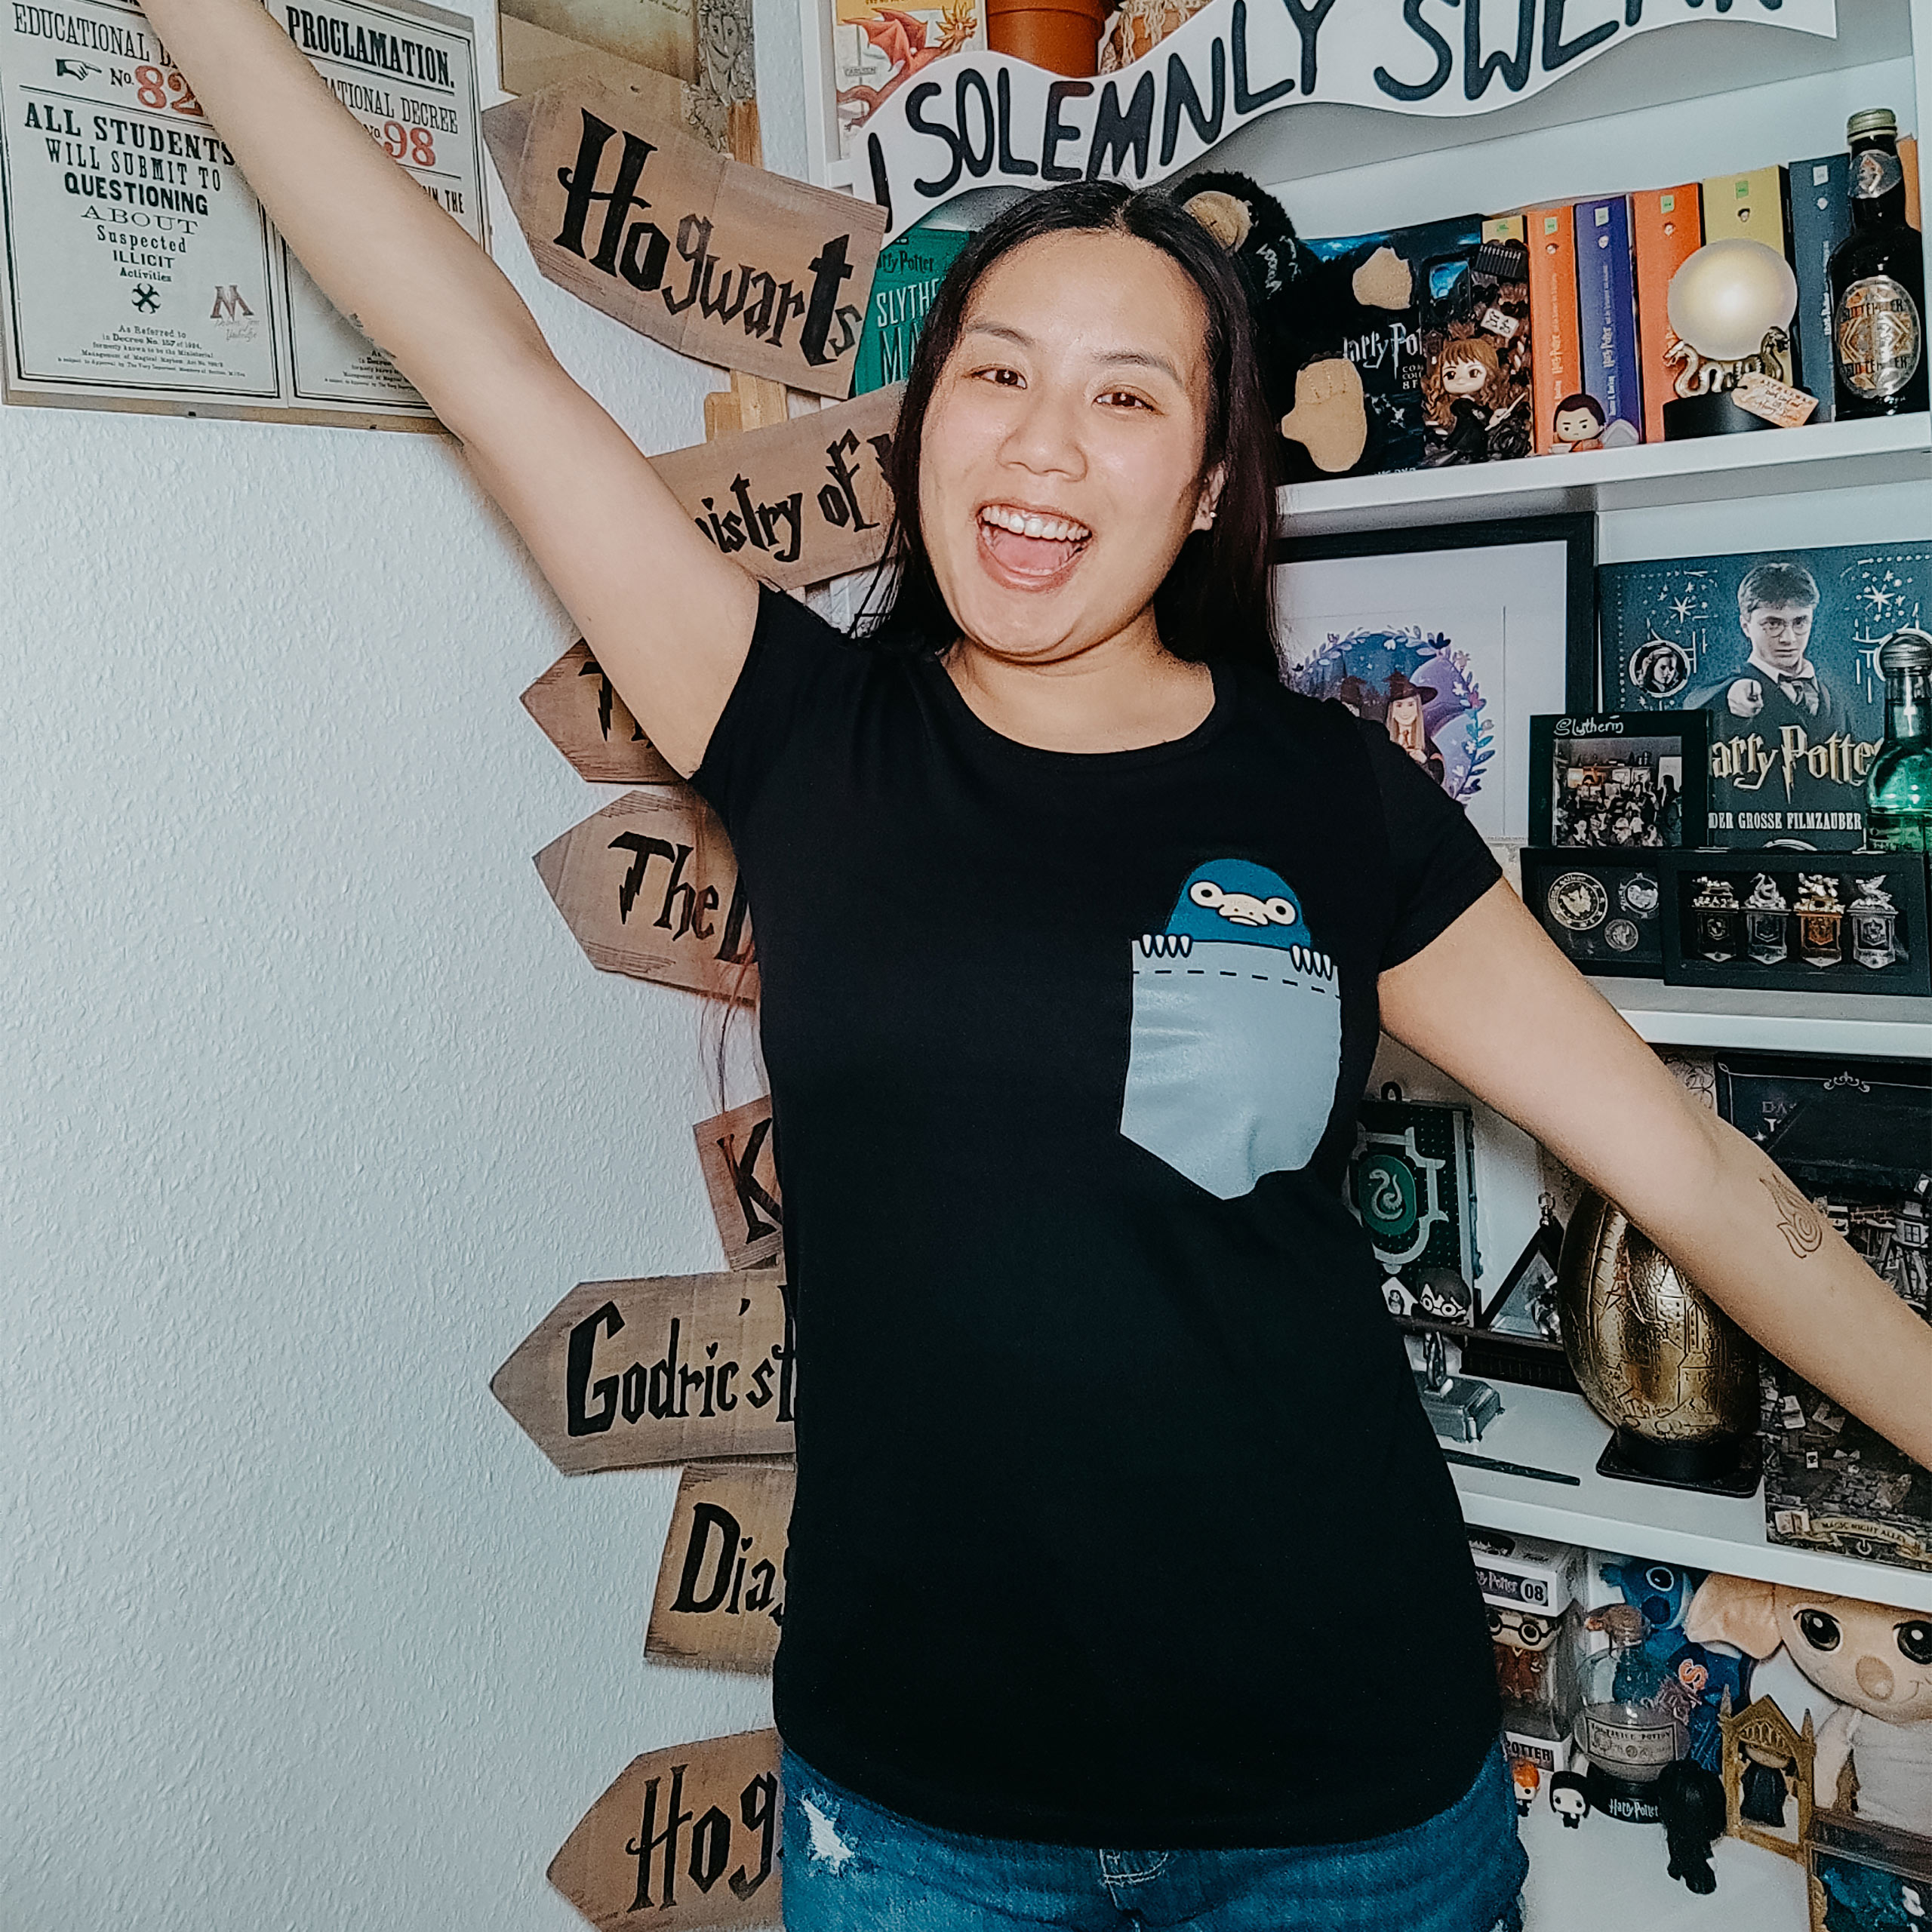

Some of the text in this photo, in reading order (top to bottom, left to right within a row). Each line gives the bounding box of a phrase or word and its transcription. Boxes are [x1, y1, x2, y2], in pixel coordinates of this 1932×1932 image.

[12, 2, 150, 62] EDUCATIONAL
[110, 65, 205, 118] No. 82
[400, 97, 459, 134] DECREE
[868, 133, 893, 233] I
[906, 0, 1336, 197] SOLEMNLY
[24, 102, 236, 167] ALL STUDENTS
[383, 120, 436, 167] 98
[46, 137, 221, 192] WILL SUBMIT TO
[64, 171, 208, 216] QUESTIONING
[445, 190, 465, 214] THE
[81, 205, 198, 235] ABOUT
[97, 225, 187, 254] Suspected
[553, 107, 863, 367] Hogwarts
[112, 249, 176, 269] ILLICIT
[119, 266, 172, 282] Activities
[817, 429, 881, 532] of
[1709, 732, 1779, 791] arry
[1708, 811, 1863, 831] DER GROSSE FILMZAUBER
[608, 831, 719, 942] The
[566, 1297, 776, 1438] Godric's
[669, 1502, 784, 1627] Dia
[1524, 1583, 1545, 1602] 08
[1608, 1798, 1635, 1818] Harry
